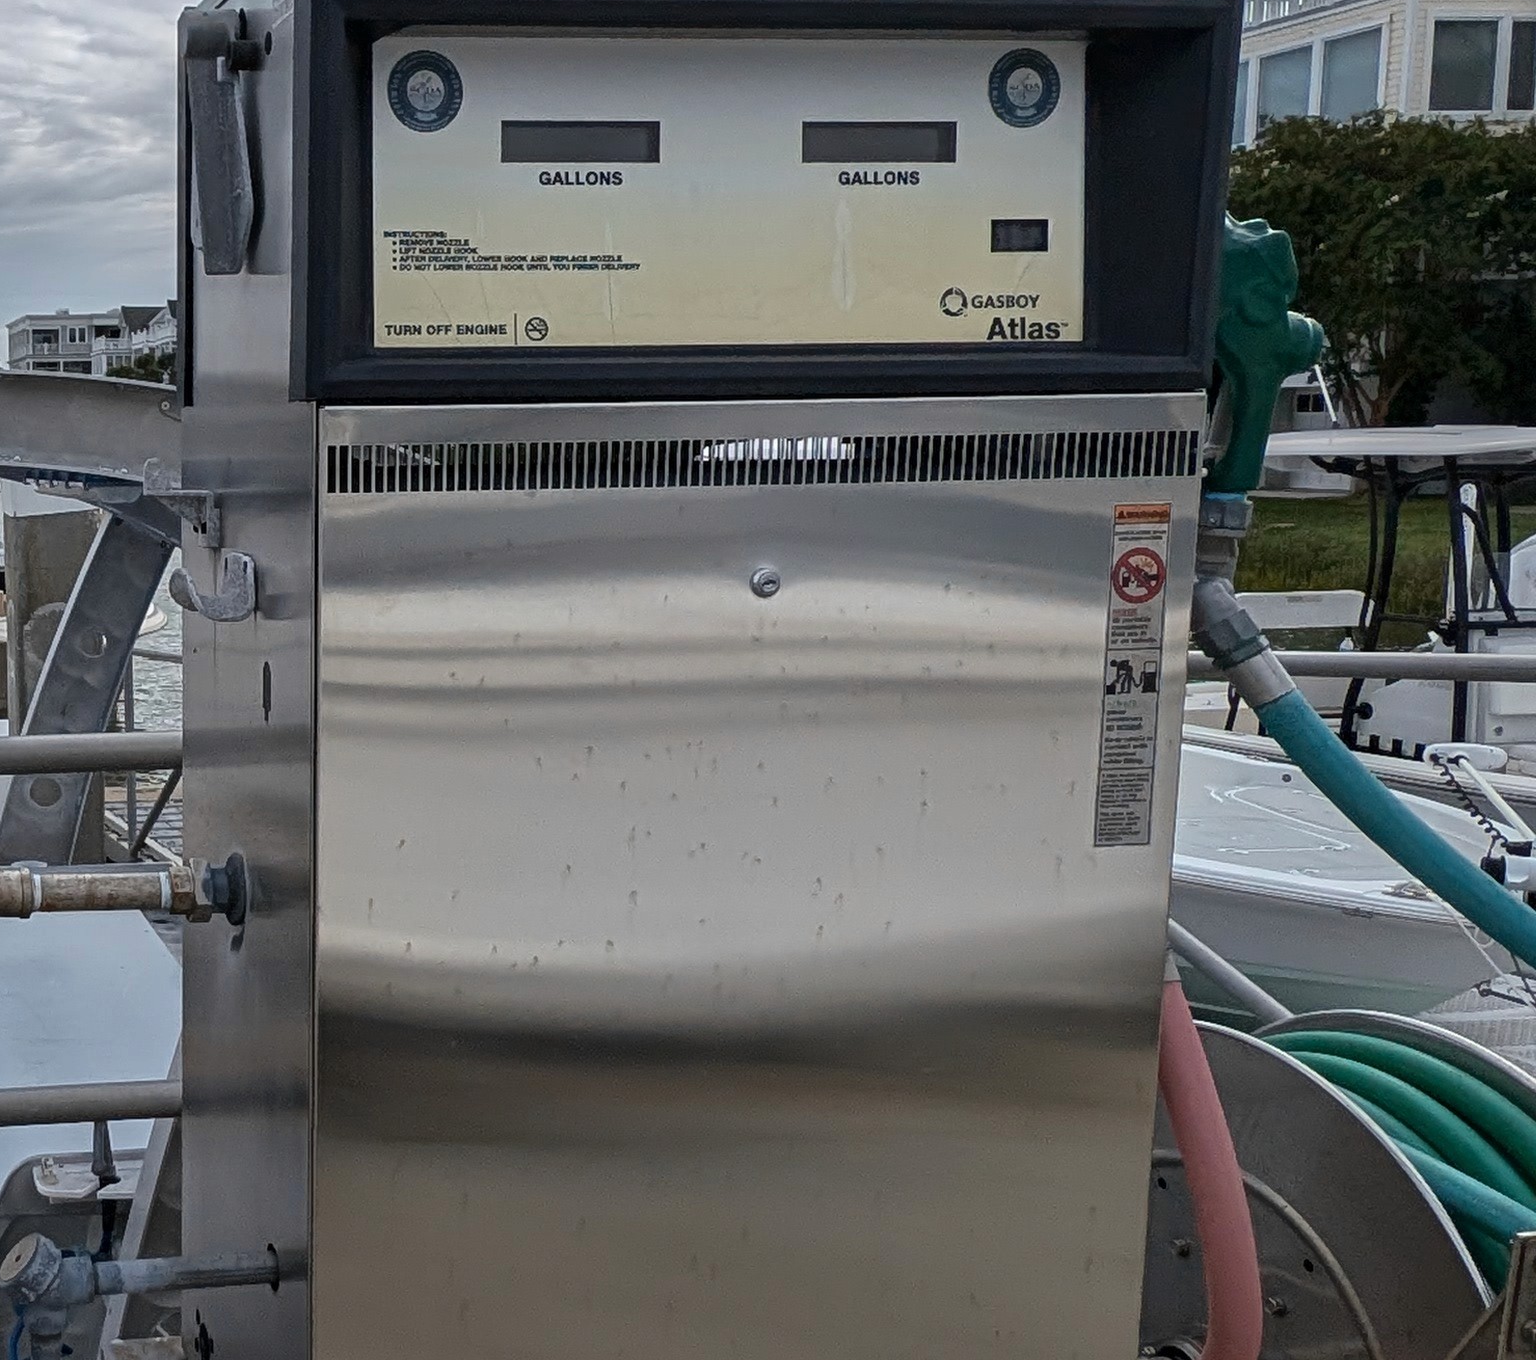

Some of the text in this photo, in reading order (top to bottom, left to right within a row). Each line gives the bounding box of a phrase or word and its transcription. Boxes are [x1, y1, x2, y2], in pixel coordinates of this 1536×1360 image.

[538, 171, 623, 186] GALLONS
[837, 170, 920, 186] GALLONS
[971, 294, 1041, 309] GASBOY
[384, 324, 508, 336] TURN OFF ENGINE
[986, 316, 1061, 340] Atlas
